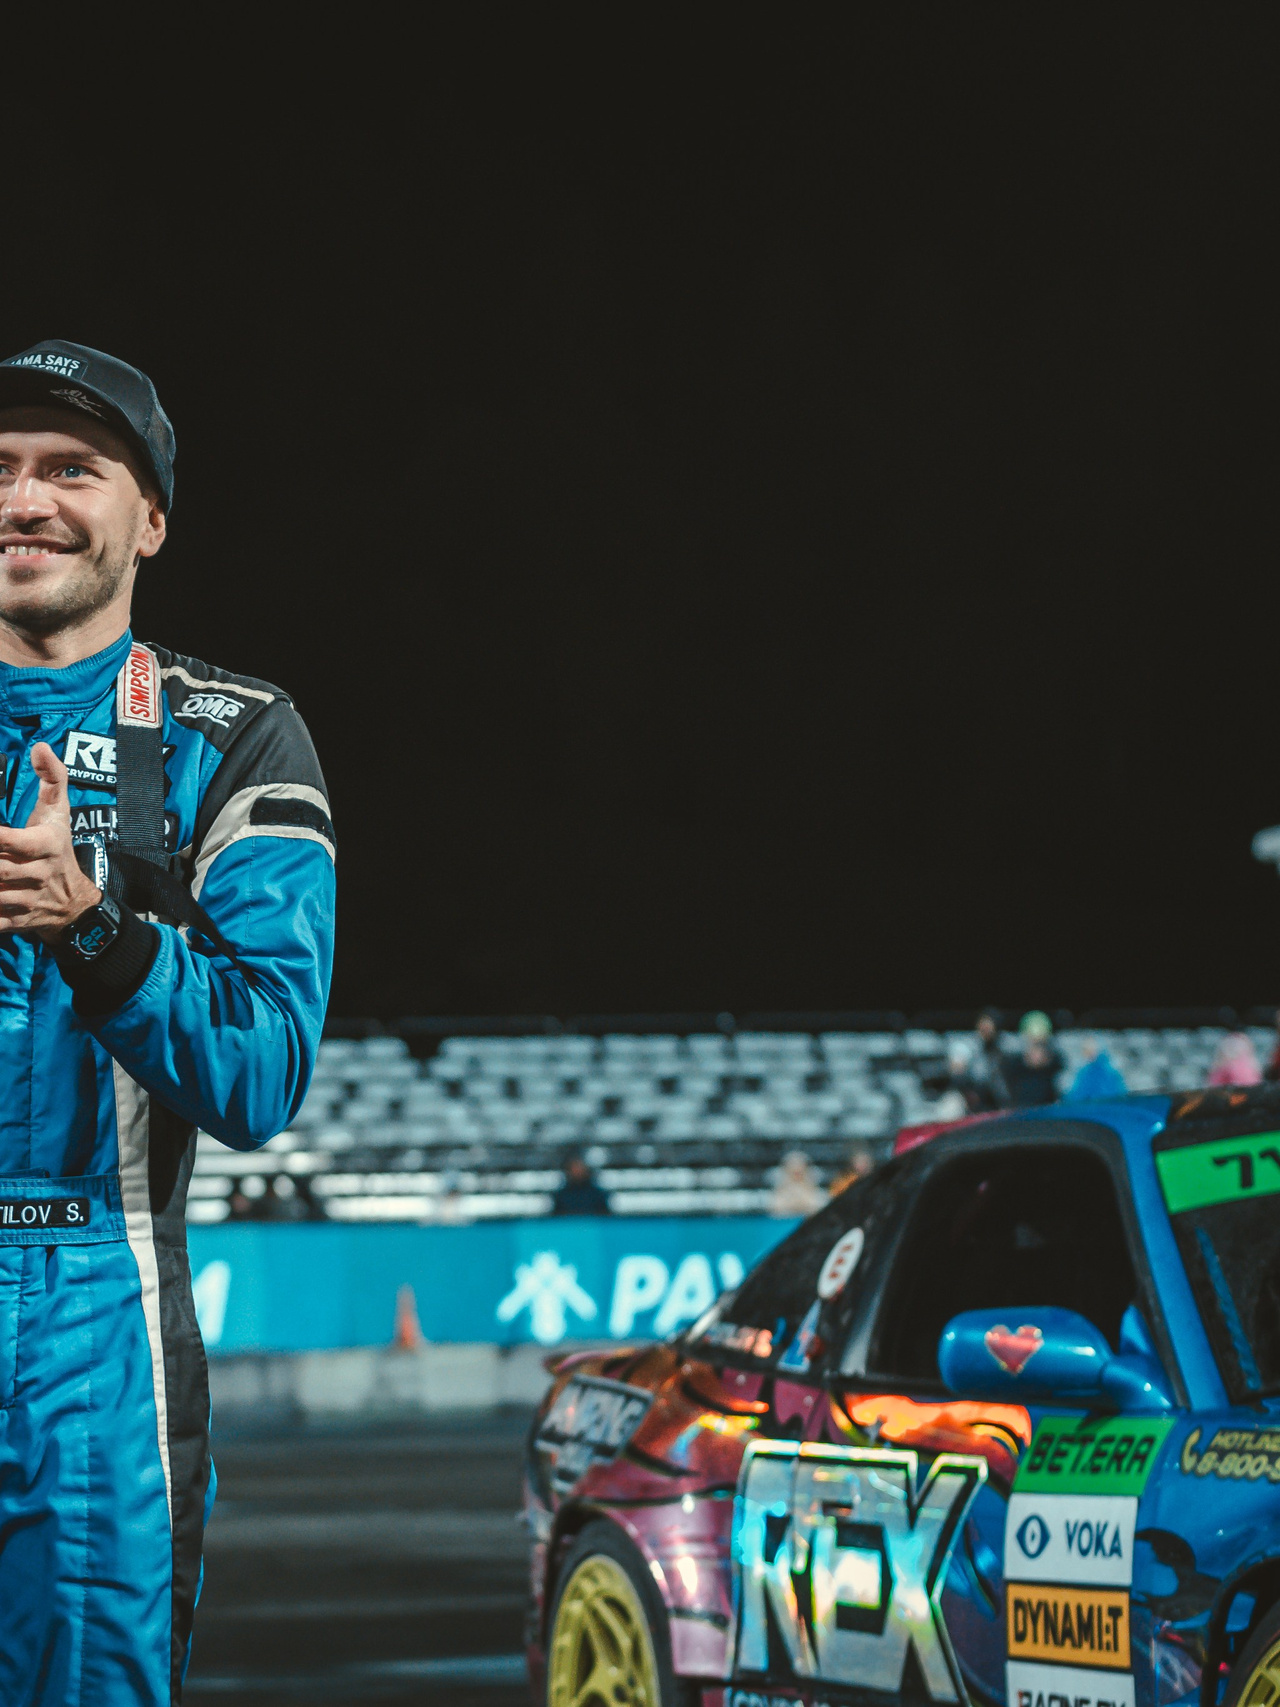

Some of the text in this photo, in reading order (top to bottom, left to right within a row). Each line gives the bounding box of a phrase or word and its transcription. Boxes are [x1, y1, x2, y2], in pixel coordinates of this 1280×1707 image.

[11, 354, 80, 369] AMA SAYS
[130, 649, 150, 718] SIMPSON
[181, 697, 240, 719] OMP
[66, 1203, 84, 1222] S.
[1066, 1520, 1123, 1558] VOKA
